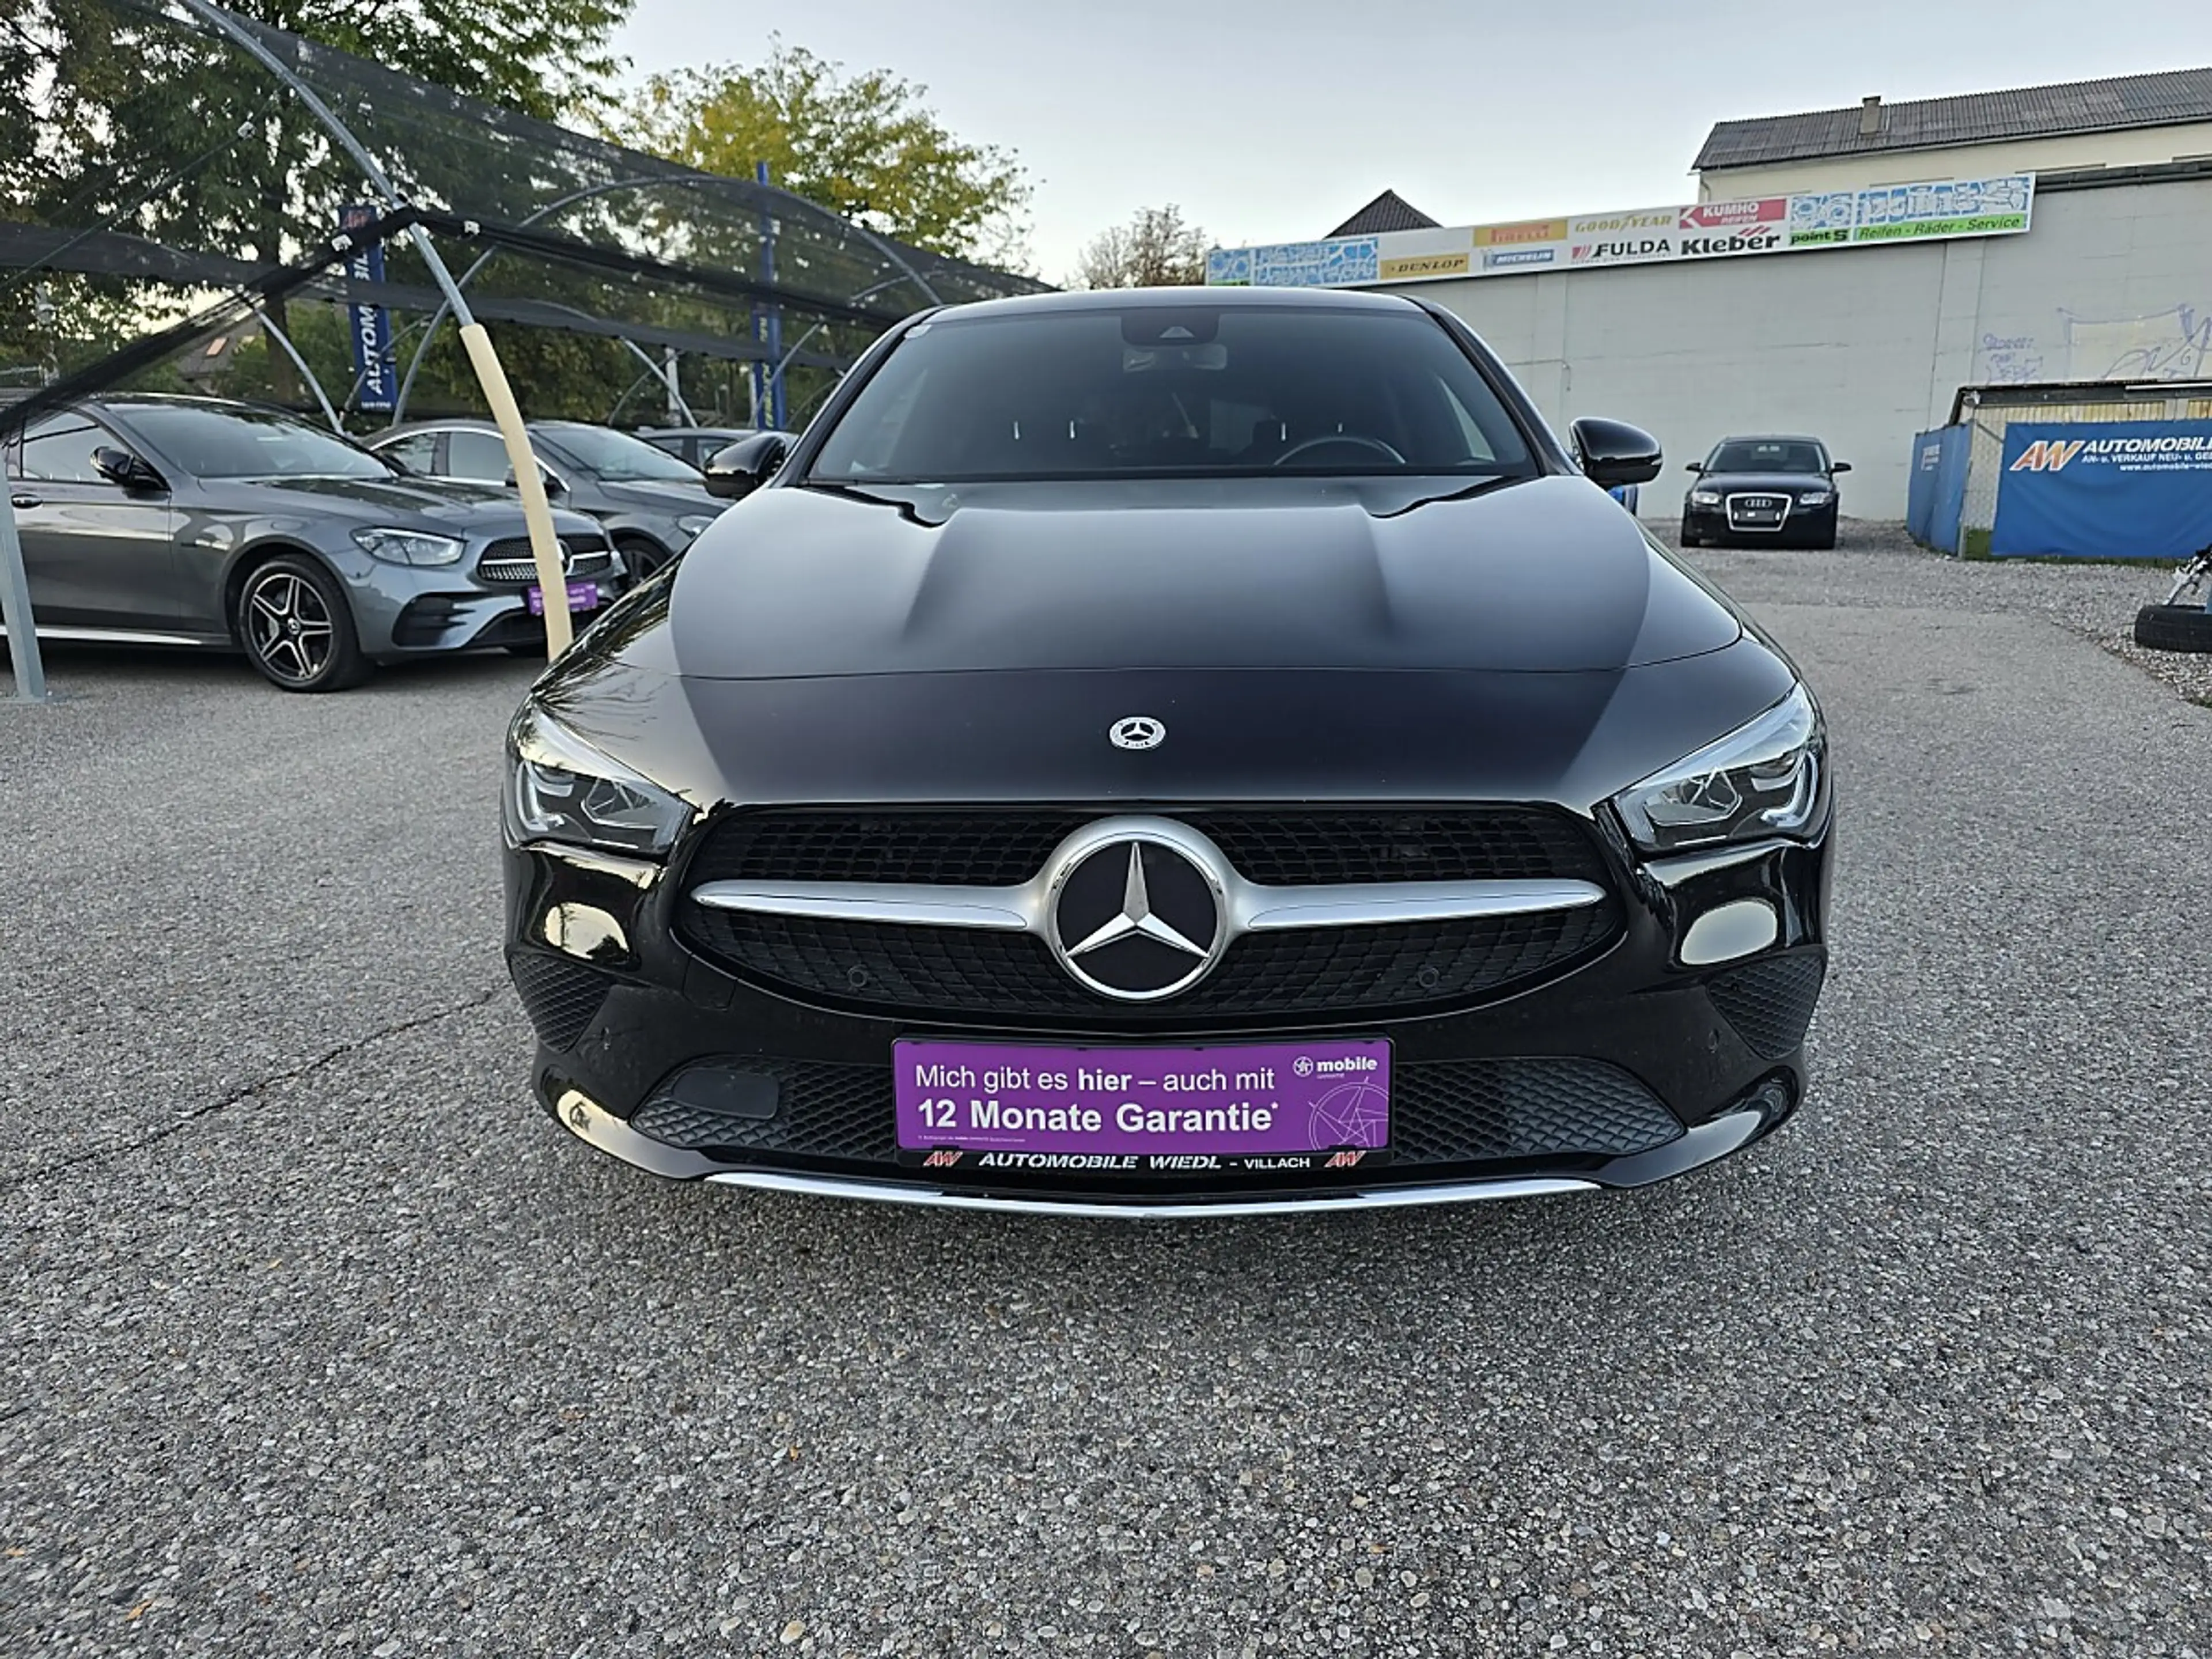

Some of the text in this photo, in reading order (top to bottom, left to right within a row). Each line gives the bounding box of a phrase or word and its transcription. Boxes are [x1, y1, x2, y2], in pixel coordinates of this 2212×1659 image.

[1702, 202, 1759, 218] KUMHO
[1575, 215, 1672, 232] GOODYEAR
[1859, 225, 1902, 240] Reifen
[1966, 217, 2020, 230] Service
[1681, 234, 1781, 255] Kleber
[1790, 230, 1848, 246] point S
[1497, 250, 1552, 263] MICHELIN
[1591, 238, 1671, 259] FULDA
[1397, 258, 1465, 272] DUNLOP
[2009, 440, 2086, 472] AW
[2111, 453, 2157, 463] VERKAUF
[1316, 1056, 1378, 1073] mobile
[916, 1065, 976, 1088] Mich
[983, 1066, 1031, 1094] gibt
[1037, 1071, 1068, 1090] es
[1078, 1068, 1132, 1091] hier
[1162, 1068, 1228, 1091] auch
[1236, 1067, 1275, 1090] mit
[918, 1098, 957, 1127] 12
[970, 1100, 1102, 1132] Monate
[923, 1150, 964, 1167] AW
[979, 1153, 1138, 1169] AUTOMOBILE
[1150, 1155, 1222, 1171] WIEDL
[1244, 1157, 1310, 1169] VILLACH
[1324, 1150, 1367, 1168] AW
